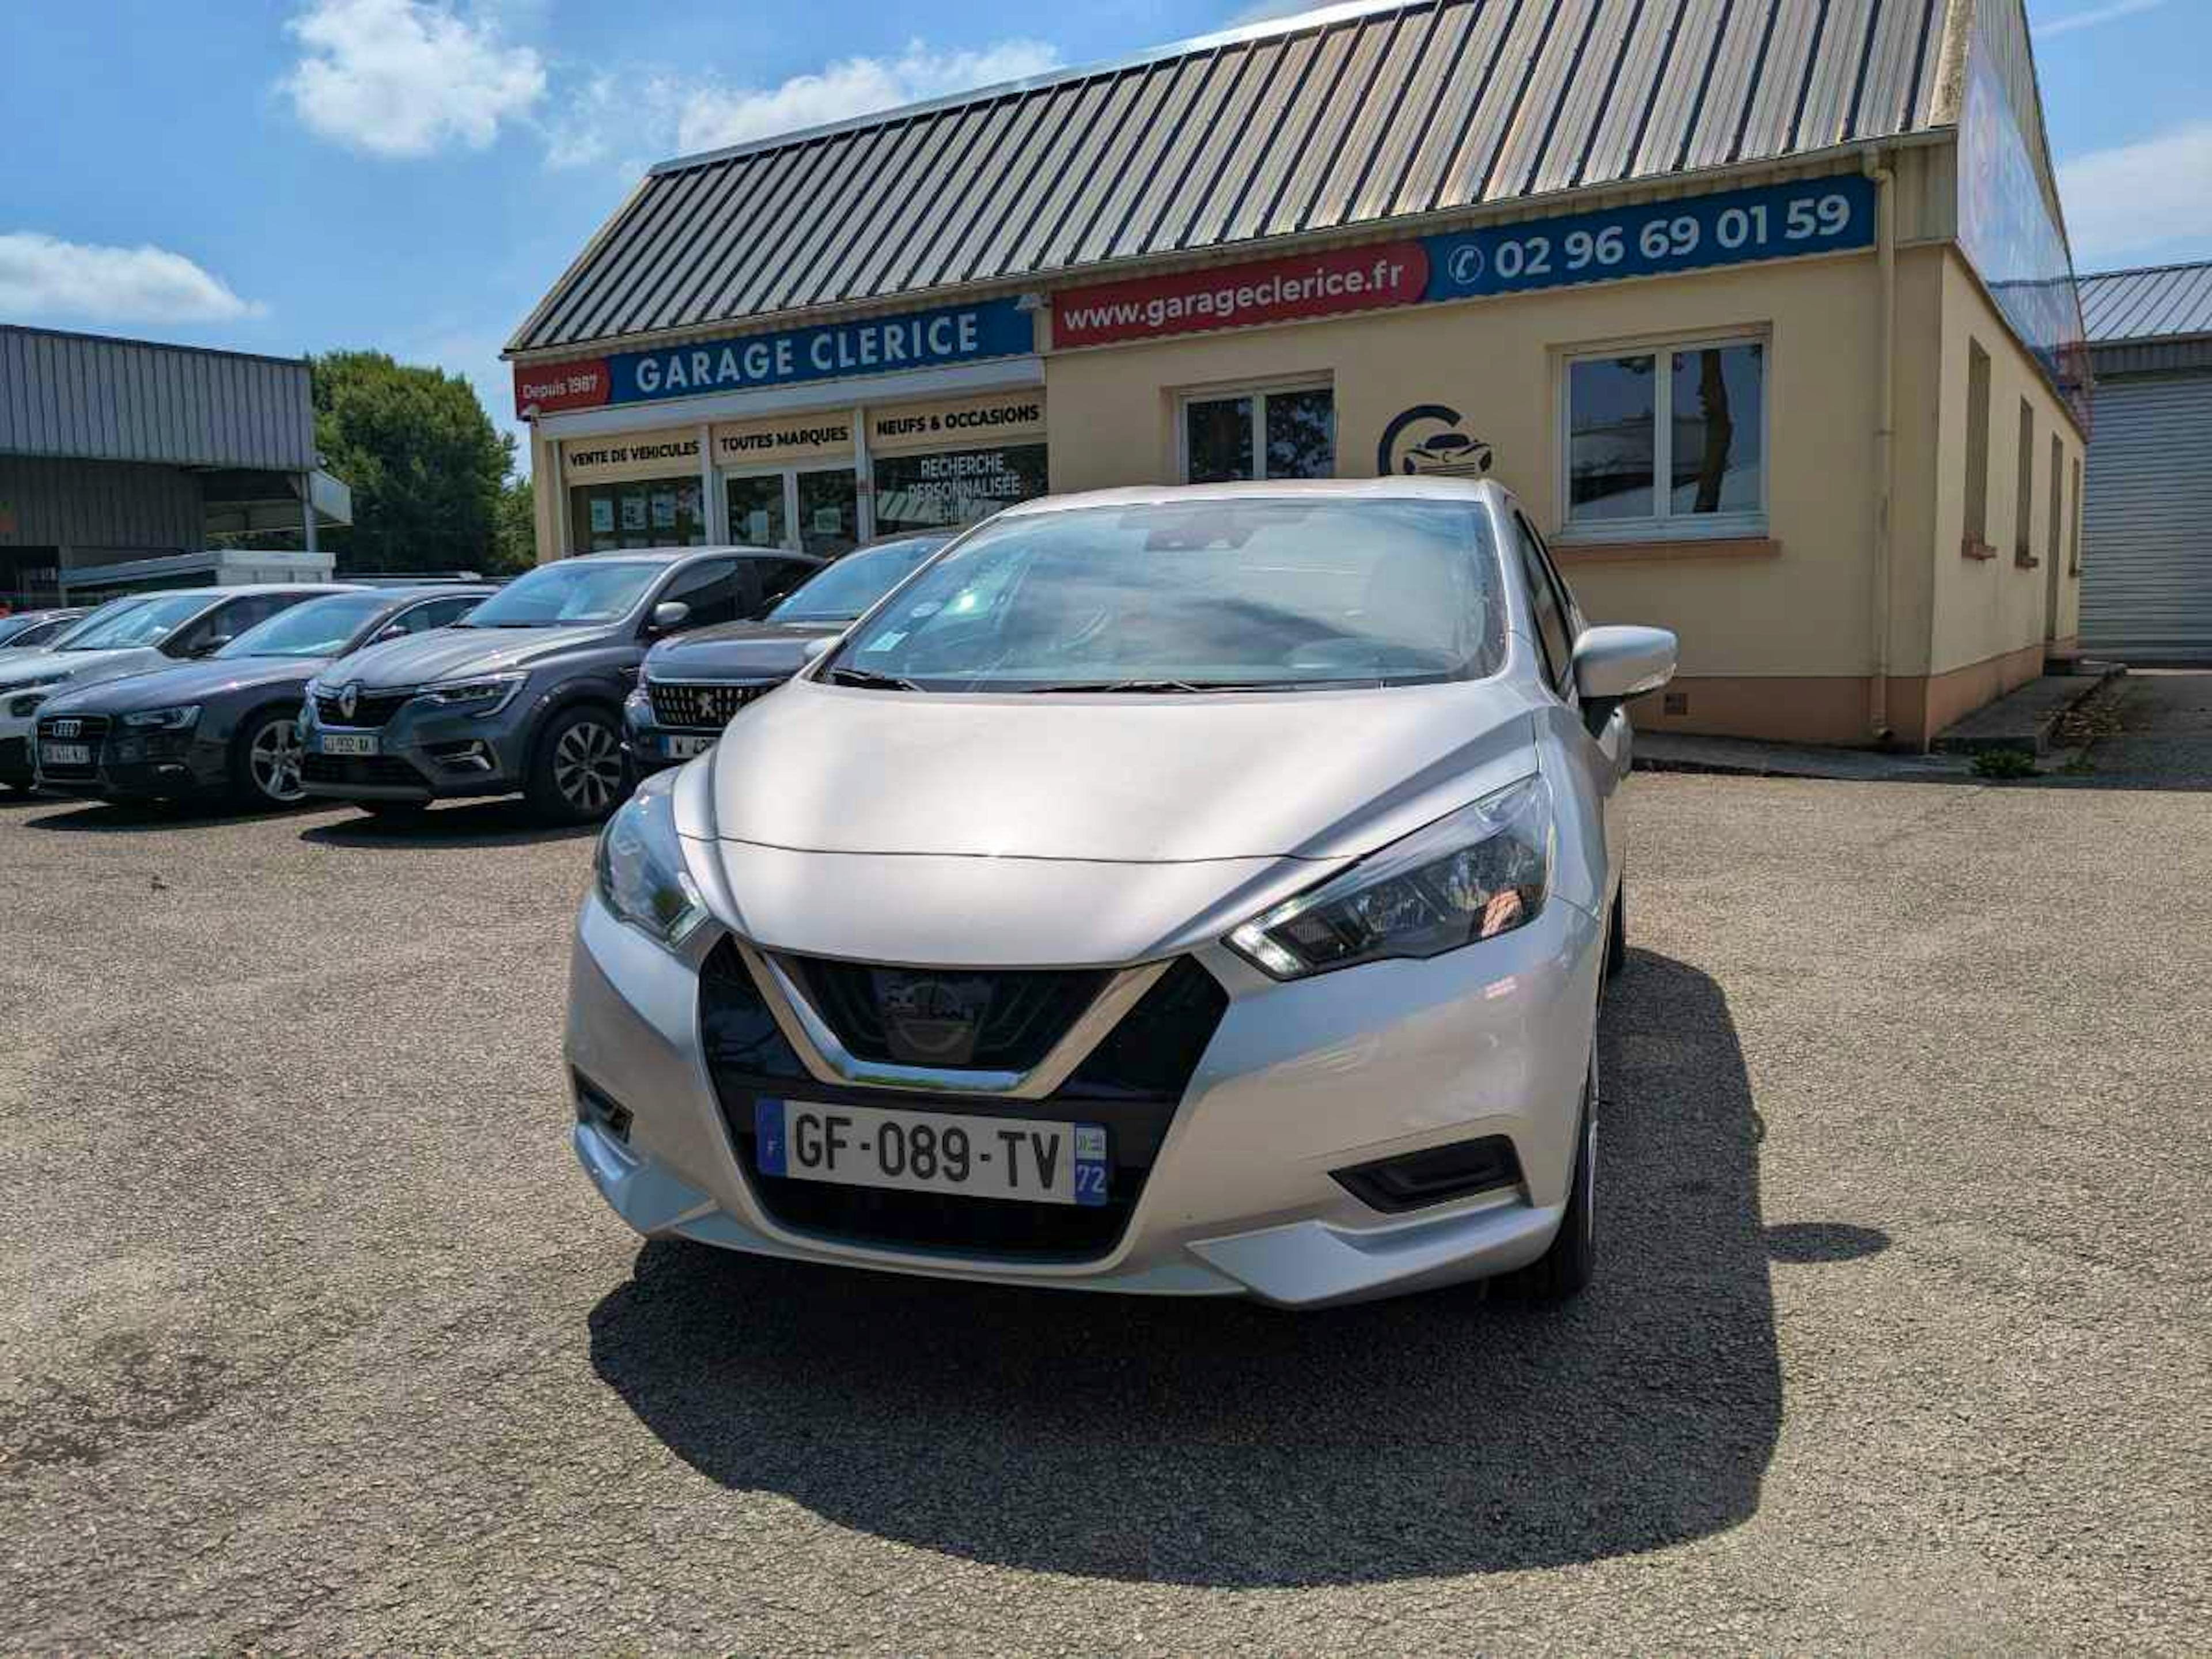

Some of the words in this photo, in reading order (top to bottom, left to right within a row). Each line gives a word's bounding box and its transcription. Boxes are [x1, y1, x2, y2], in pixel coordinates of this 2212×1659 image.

[1064, 260, 1404, 331] www.garageclerice.fr
[1495, 237, 1551, 278] 02
[1564, 226, 1625, 270] 96
[1639, 215, 1699, 259] 69
[1717, 205, 1767, 248] 01
[1785, 195, 1850, 239] 59
[636, 338, 794, 392] GARAGE
[810, 312, 978, 370] CLERICE
[522, 381, 567, 399] Depuis
[568, 375, 598, 394] 1987
[877, 416, 926, 435] NEUFS
[930, 416, 940, 431] &
[945, 404, 1039, 428] OCCASIONS
[721, 433, 772, 452] TOUTES
[777, 426, 849, 447] MARQUES
[570, 449, 609, 467] VENTE
[611, 449, 627, 463] DE
[921, 453, 1004, 479] RECHERCHE
[795, 1113, 1060, 1190] GF-089-TV
[1077, 1164, 1106, 1194] 72
